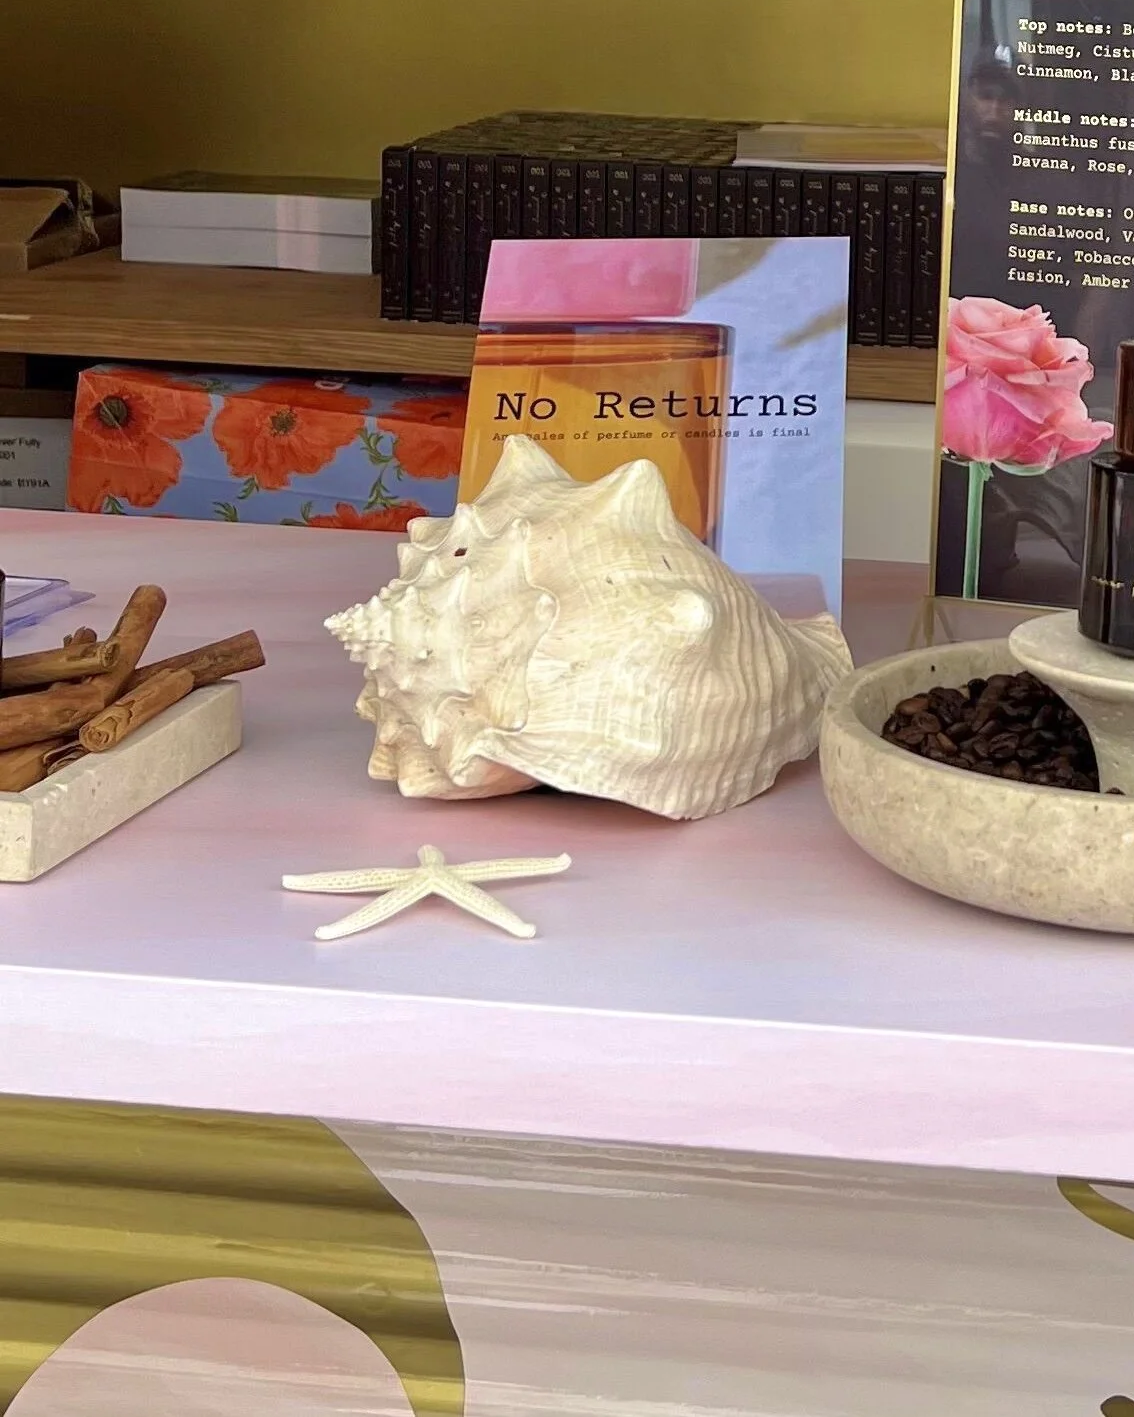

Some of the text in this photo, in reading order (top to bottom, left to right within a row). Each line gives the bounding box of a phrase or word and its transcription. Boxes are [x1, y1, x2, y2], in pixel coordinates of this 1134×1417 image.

[1018, 18, 1047, 33] Top
[1056, 21, 1112, 35] notes:
[1017, 41, 1082, 58] Nutmeg,
[1016, 64, 1100, 81] Cinnamon,
[1013, 109, 1071, 124] Middle
[1013, 132, 1098, 149] Osmanthus
[1012, 155, 1077, 172] Davana,
[1088, 160, 1133, 176] Rose,
[1010, 200, 1048, 215] Base
[1057, 204, 1113, 219] notes:
[1009, 222, 1111, 243] Sandalwood,
[1008, 246, 1063, 263] Sugar,
[1007, 268, 1131, 289] fusion, Amber
[494, 389, 818, 421] No Returns
[492, 432, 510, 441] An
[573, 430, 590, 440] of
[597, 430, 653, 441] perfume
[661, 431, 676, 439] or
[685, 429, 739, 439] candles
[749, 429, 764, 438] is
[772, 428, 811, 437] final
